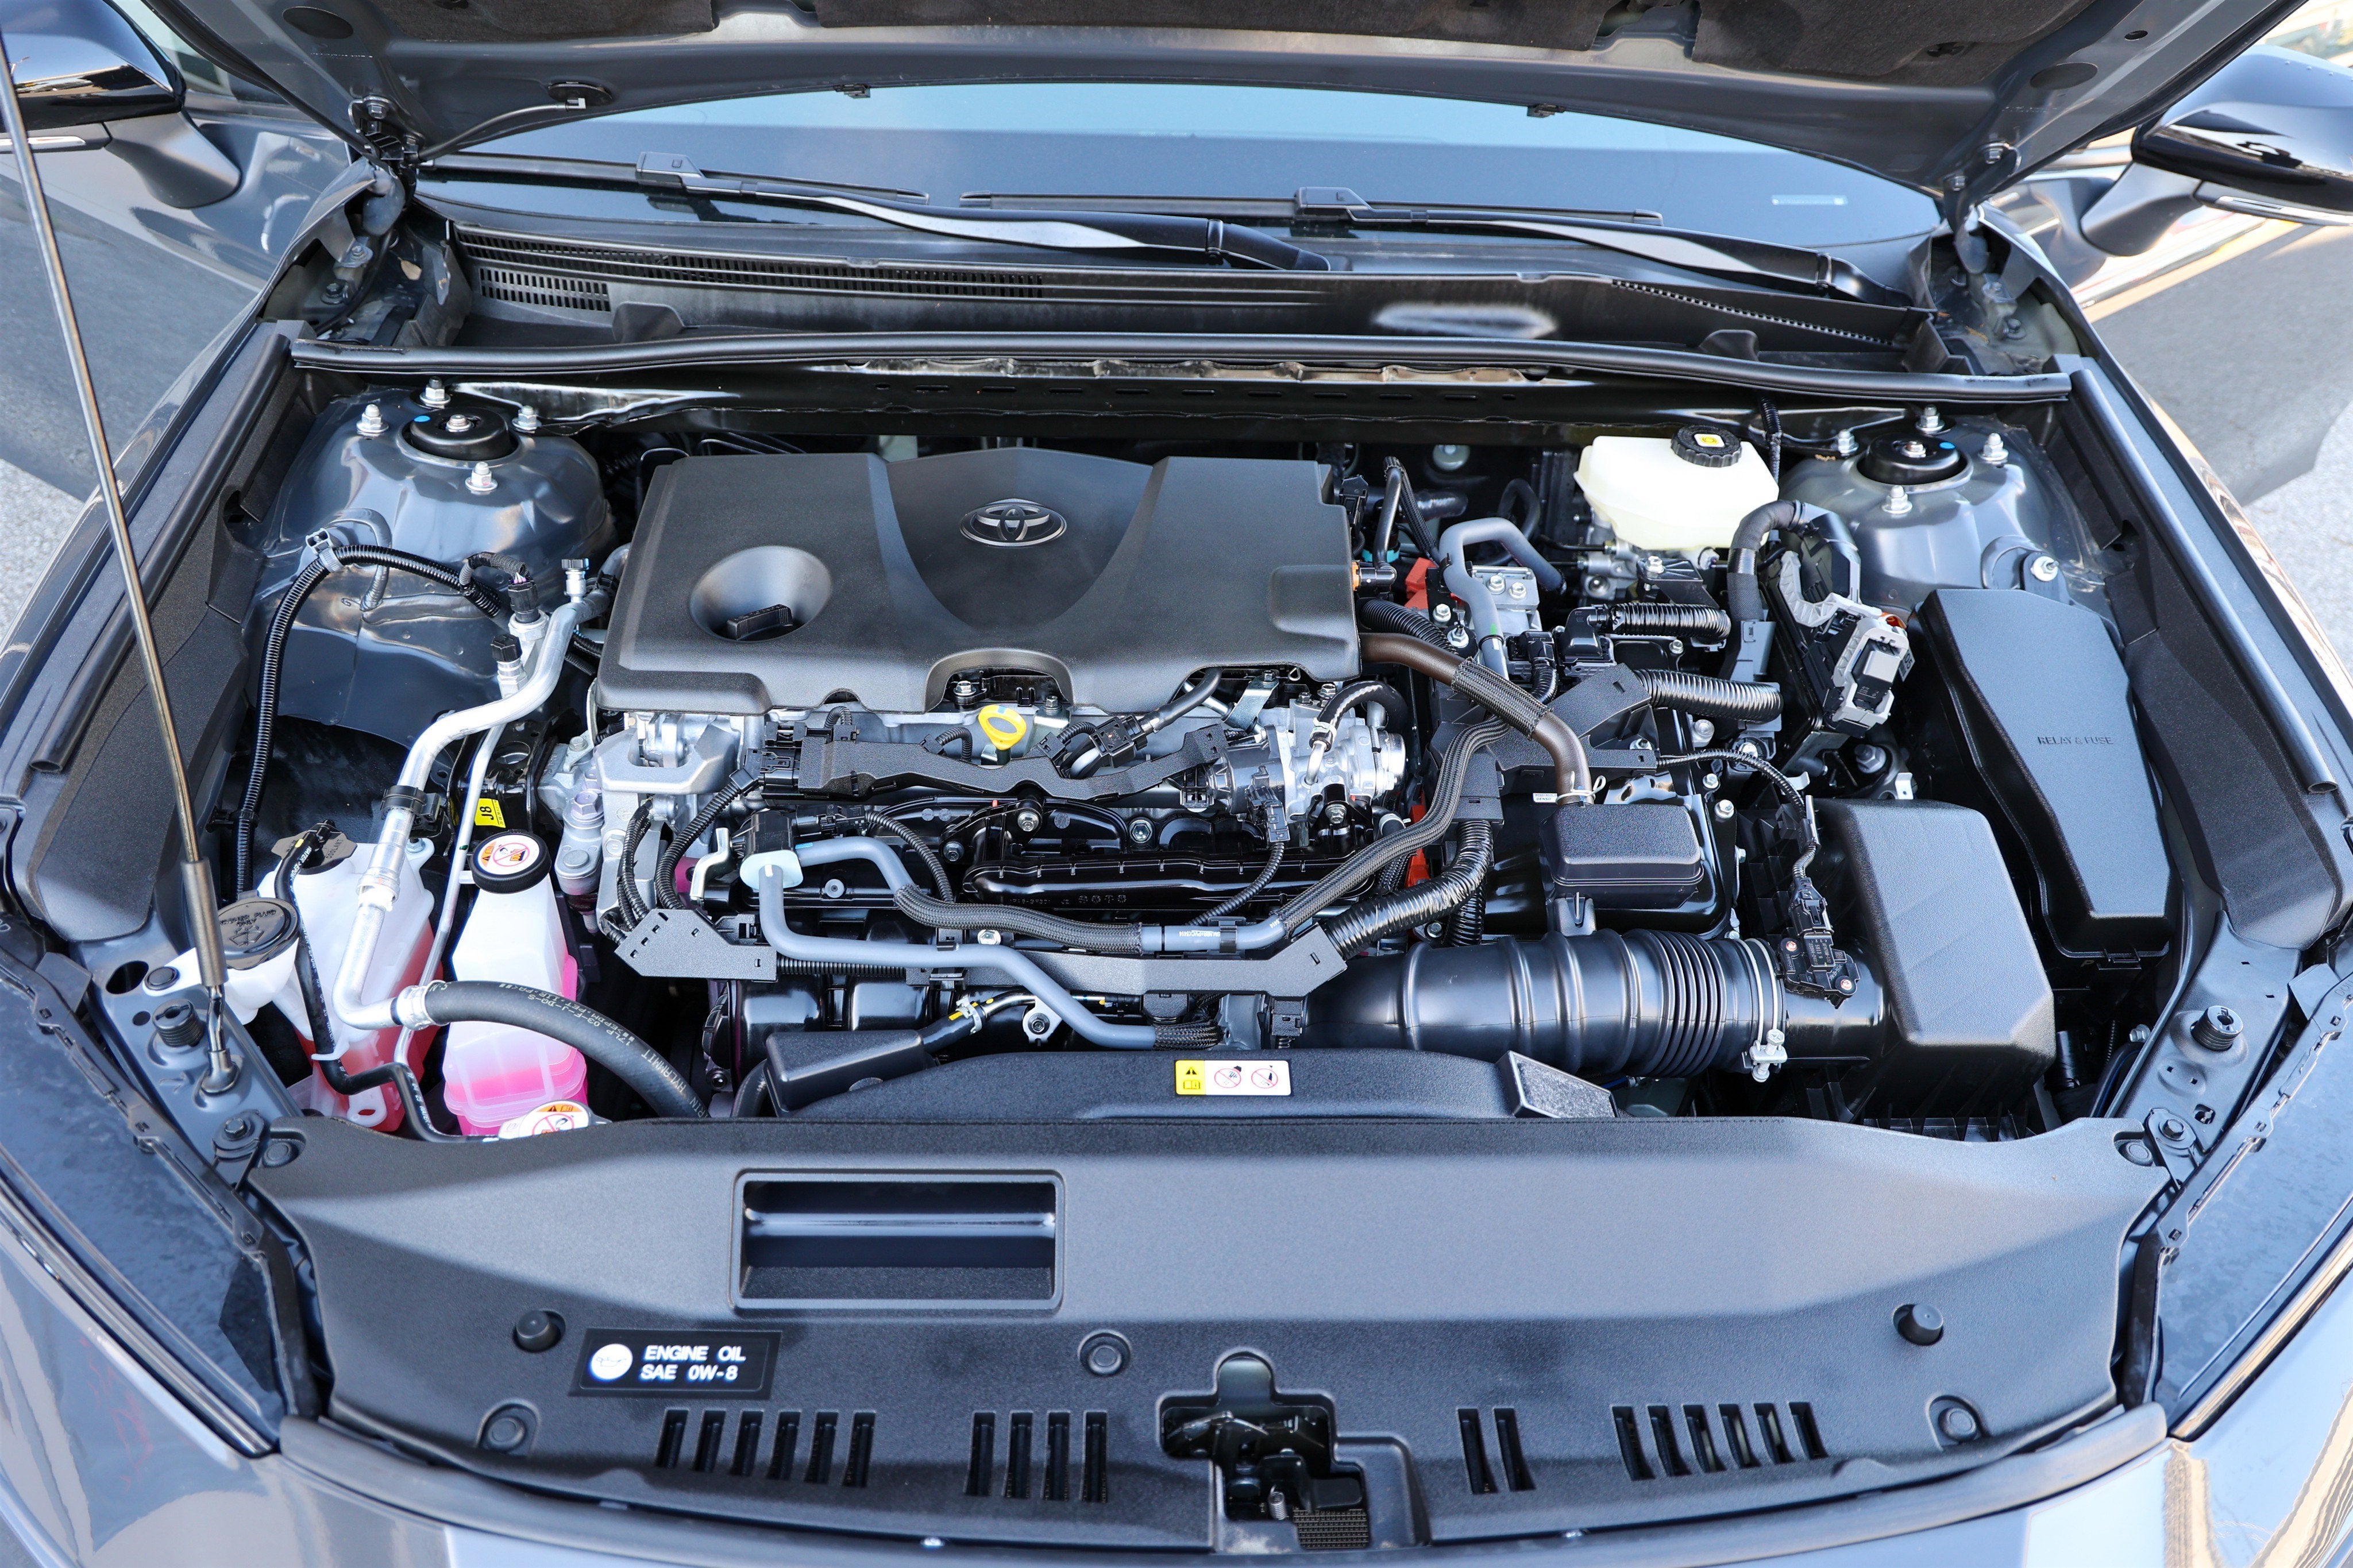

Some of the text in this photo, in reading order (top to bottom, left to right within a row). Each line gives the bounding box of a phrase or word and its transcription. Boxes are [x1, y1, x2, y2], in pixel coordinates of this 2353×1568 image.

[2038, 736, 2114, 745] RELAY & FUSE
[479, 805, 495, 821] J8
[641, 1048, 686, 1092] HYLAMMIT
[644, 1346, 746, 1361] ENGINE OIL
[641, 1365, 739, 1380] SAE 0W-8
